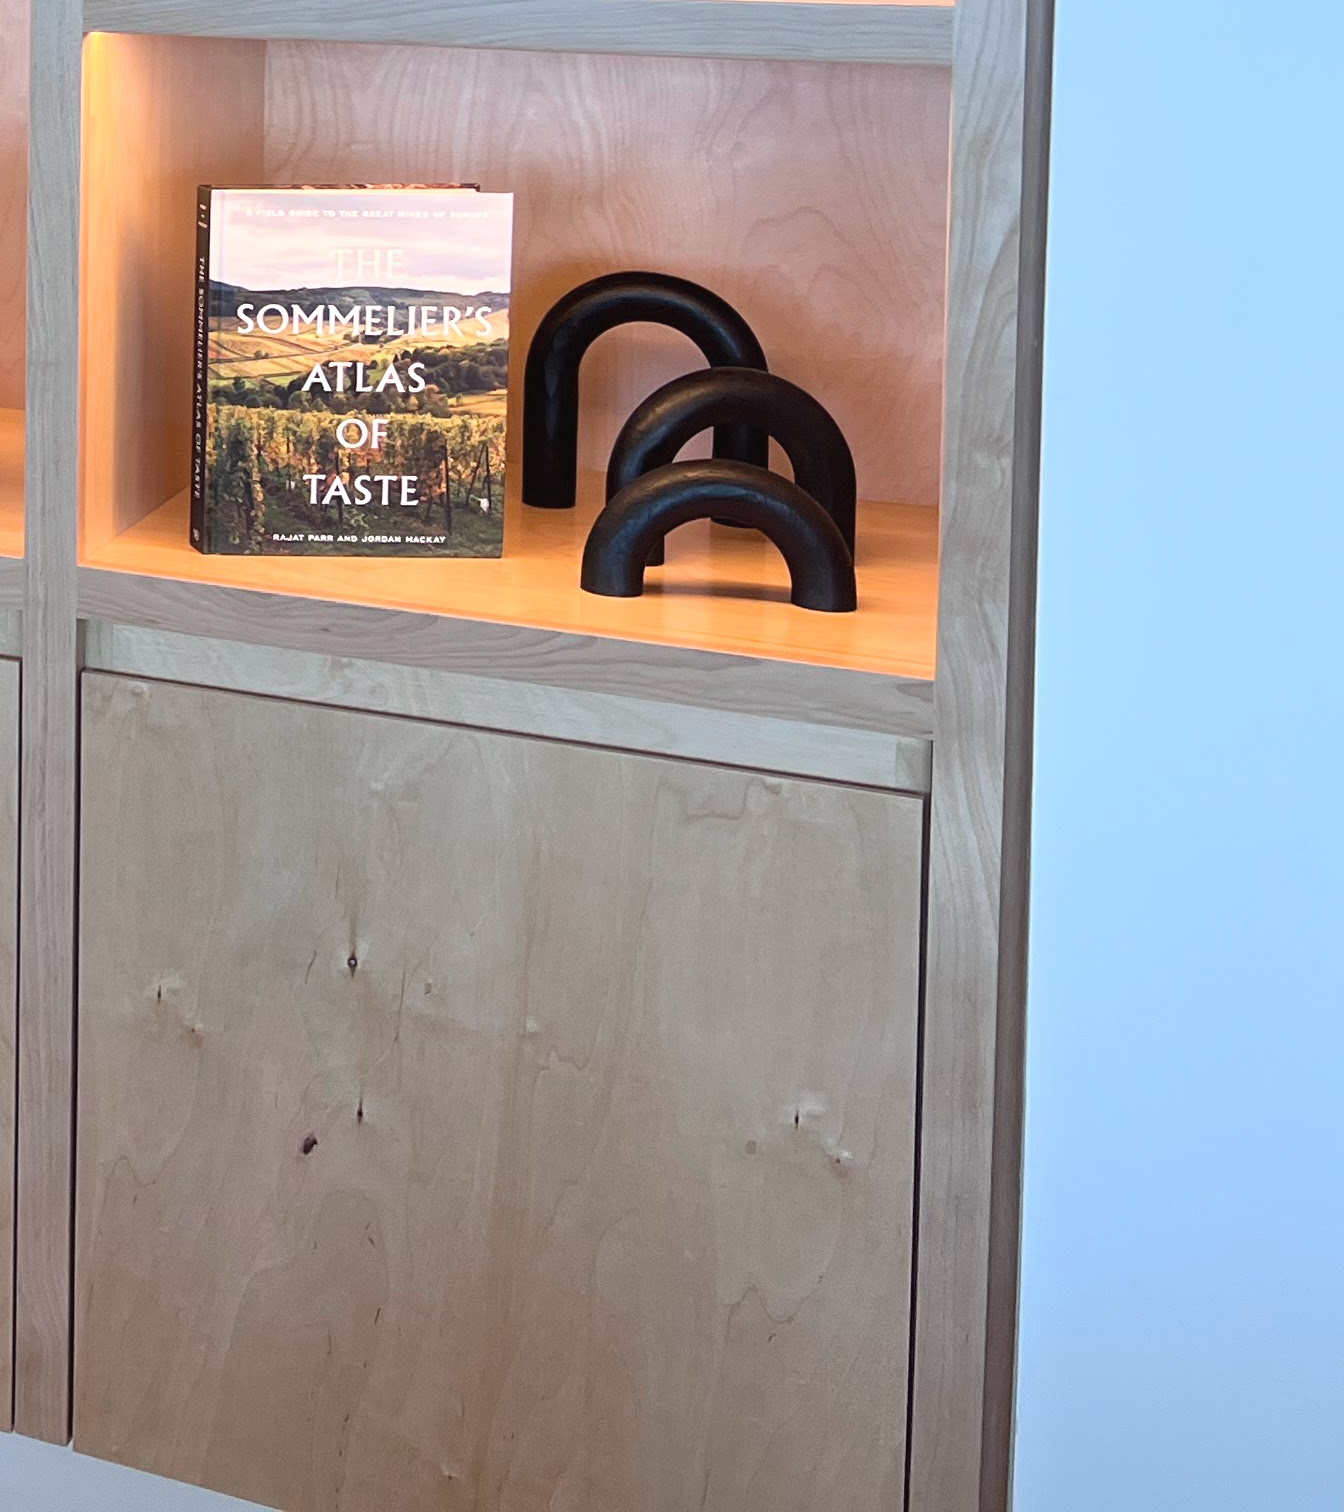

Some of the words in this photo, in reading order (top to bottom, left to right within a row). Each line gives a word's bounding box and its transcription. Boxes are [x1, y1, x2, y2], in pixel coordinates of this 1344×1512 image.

[256, 209, 286, 217] FIELD
[287, 209, 320, 218] GUIDE
[322, 209, 337, 218] TO
[338, 209, 360, 218] THE
[362, 210, 395, 218] GREAT
[330, 247, 405, 280] THE
[236, 302, 493, 337] SOMMELIER'S
[301, 361, 426, 393] ATLAS
[335, 418, 388, 449] OF
[302, 474, 420, 506] TASTE
[273, 533, 305, 542] RAJAT
[308, 534, 334, 542] PARR
[336, 535, 358, 543] AND
[361, 535, 402, 543] JORDAN
[405, 536, 446, 544] MACKAY
